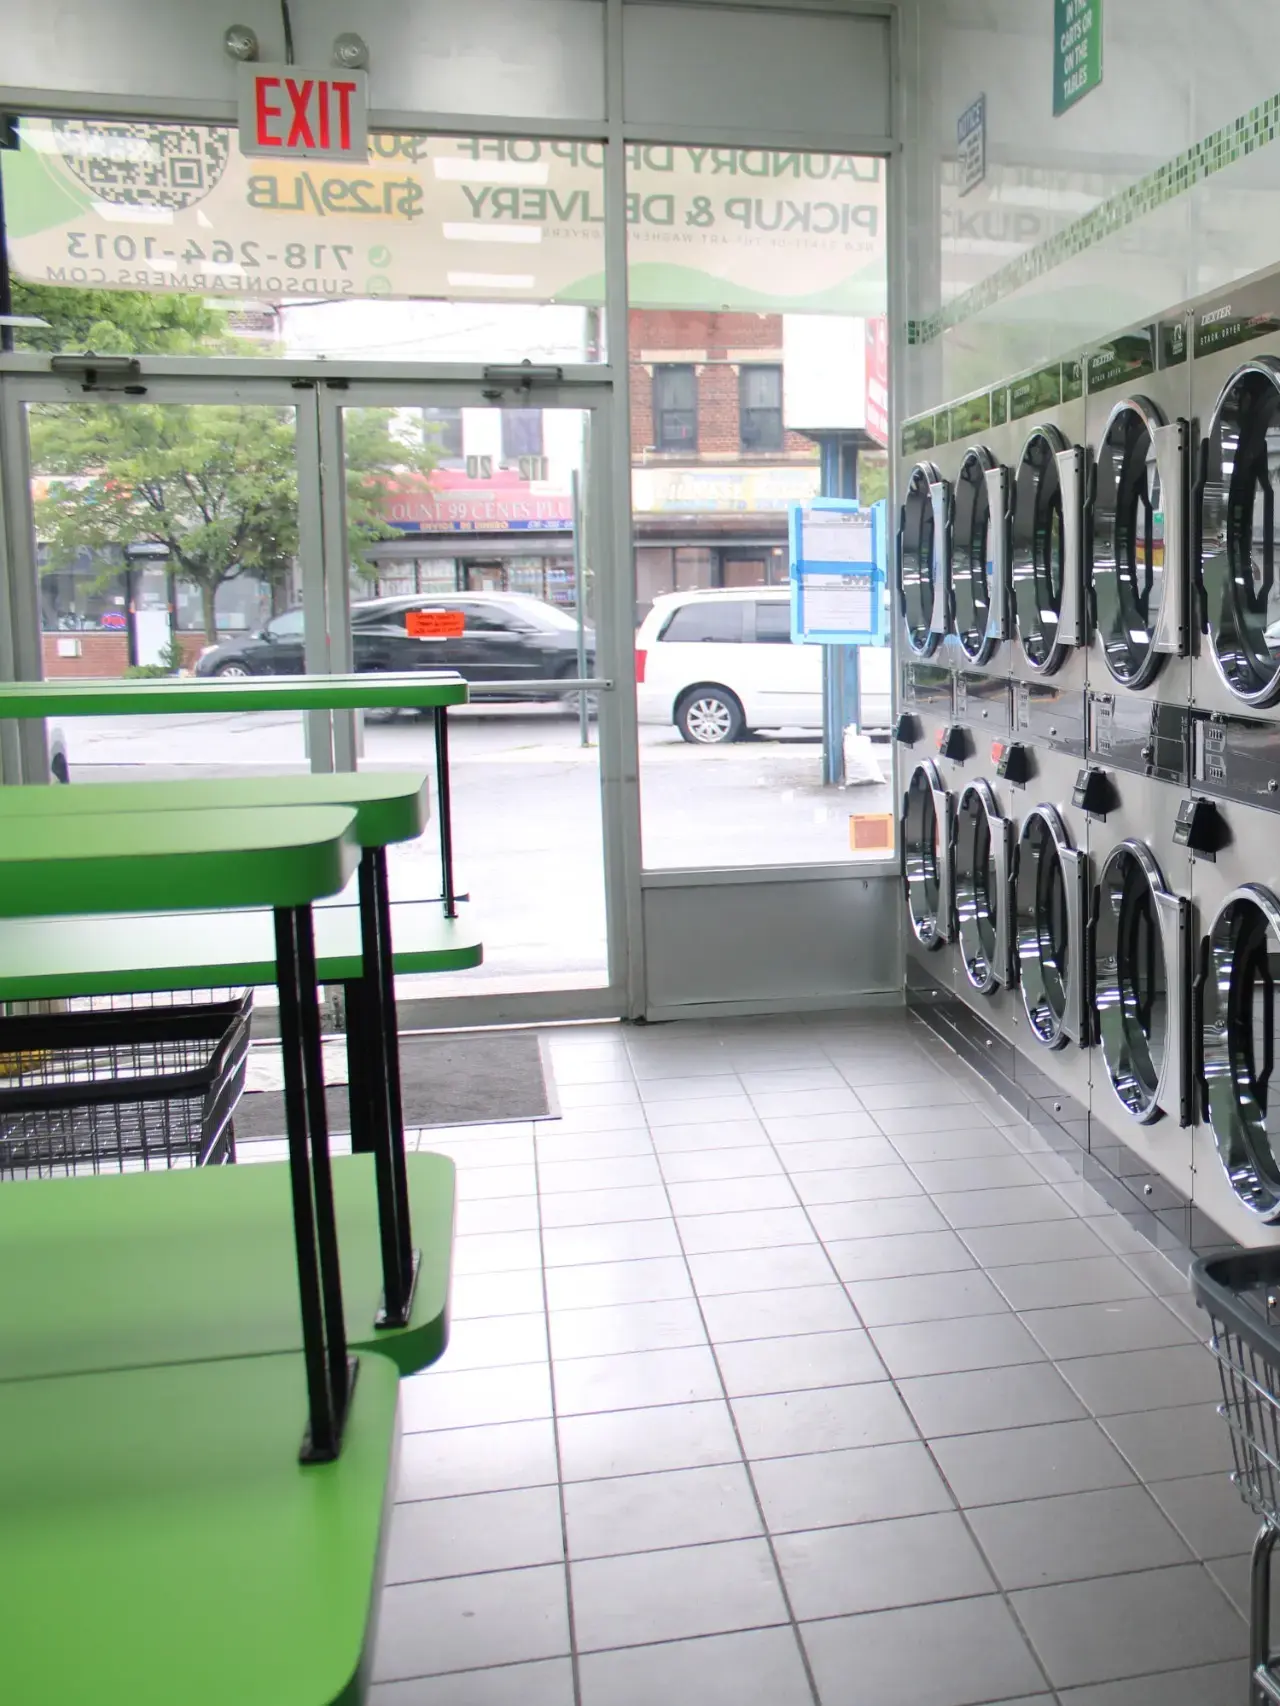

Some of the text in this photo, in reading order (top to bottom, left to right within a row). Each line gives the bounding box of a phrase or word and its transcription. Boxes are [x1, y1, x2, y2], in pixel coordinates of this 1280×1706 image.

[1061, 20, 1081, 53] CARTS
[1064, 38, 1088, 75] ON THE
[1064, 64, 1087, 100] TABLES
[255, 76, 357, 150] EXIT
[1201, 304, 1232, 327] DEXTER
[1200, 323, 1241, 346] STACK DRYER
[449, 502, 467, 520] 99
[471, 502, 531, 520] CENTS
[536, 502, 573, 520] PLU
